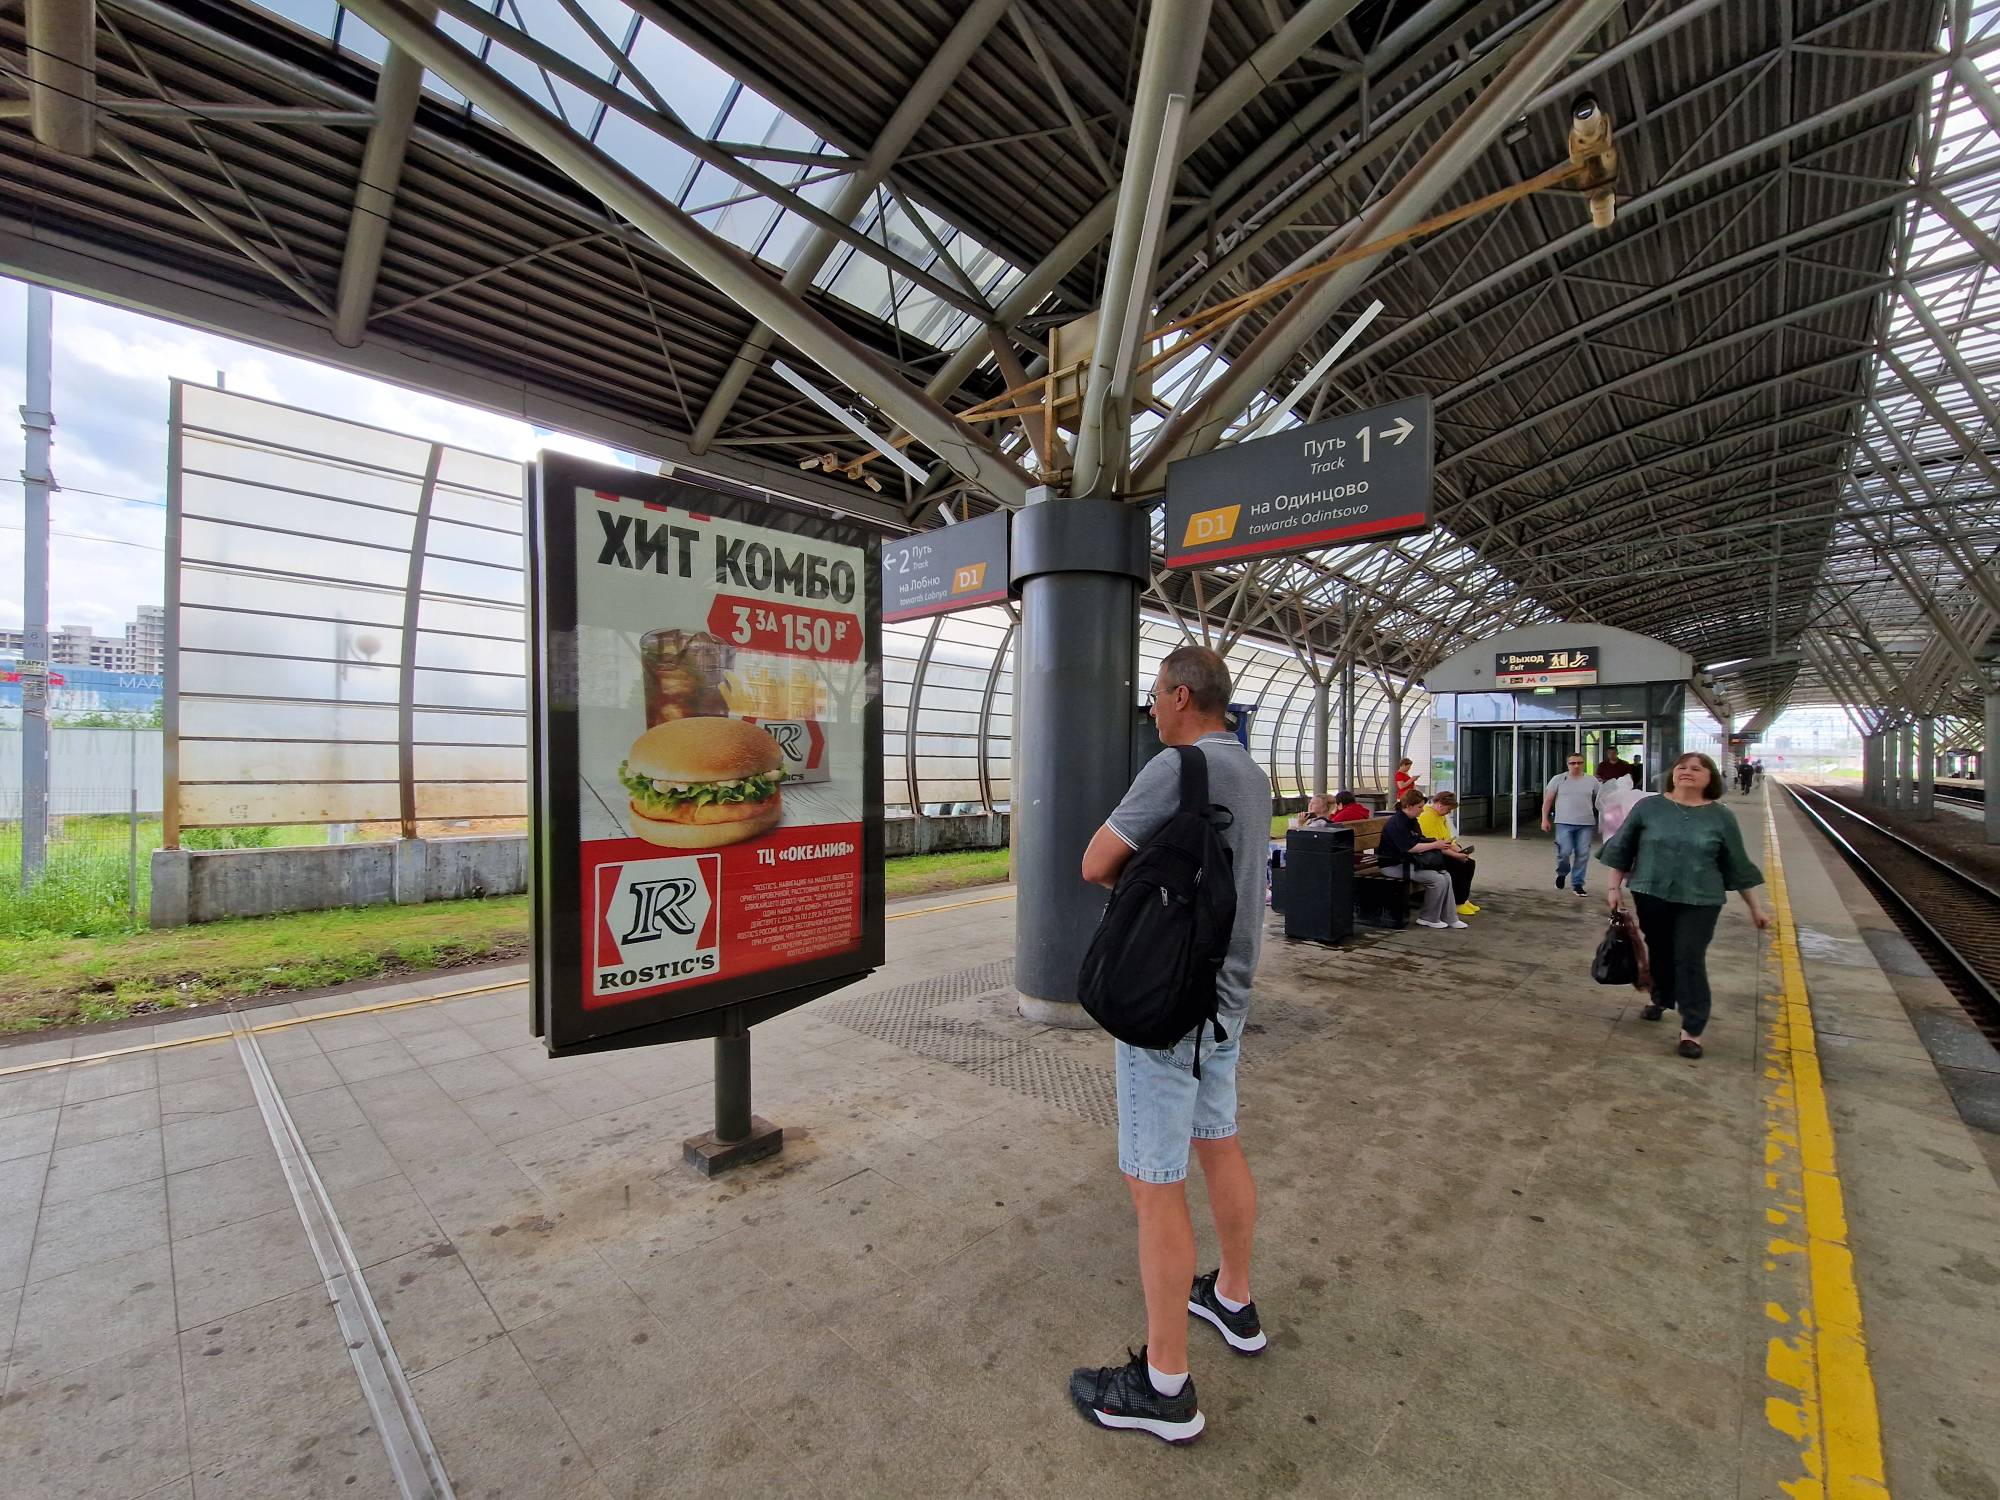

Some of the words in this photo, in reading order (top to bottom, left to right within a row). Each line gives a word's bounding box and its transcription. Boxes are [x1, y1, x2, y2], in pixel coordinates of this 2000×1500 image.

[1303, 437, 1346, 458] Путь
[1355, 425, 1370, 463] 1
[1311, 457, 1345, 475] Track
[1251, 501, 1270, 516] на
[1275, 480, 1369, 511] Одинцово
[1196, 514, 1227, 539] D1
[1249, 516, 1299, 535] towards
[1301, 503, 1368, 525] Odintsovo
[597, 509, 700, 578] ХИТ
[715, 535, 855, 604] КОМБО
[899, 548, 910, 574] 2
[912, 545, 932, 559] Путь
[913, 560, 929, 570] Track
[899, 584, 909, 593] на
[910, 576, 940, 591] Лобню
[959, 569, 979, 588] D1
[900, 593, 924, 606] towards
[924, 589, 948, 602] Lobnya
[732, 606, 752, 644] 3
[755, 609, 778, 633] ЗА
[782, 613, 832, 653] 150
[1509, 655, 1545, 664] Выход
[757, 849, 776, 866] ТЦ
[778, 841, 855, 862] «ОКЕАНИЯ»
[621, 877, 697, 945] R
[600, 954, 715, 989] ROSTIC'S
